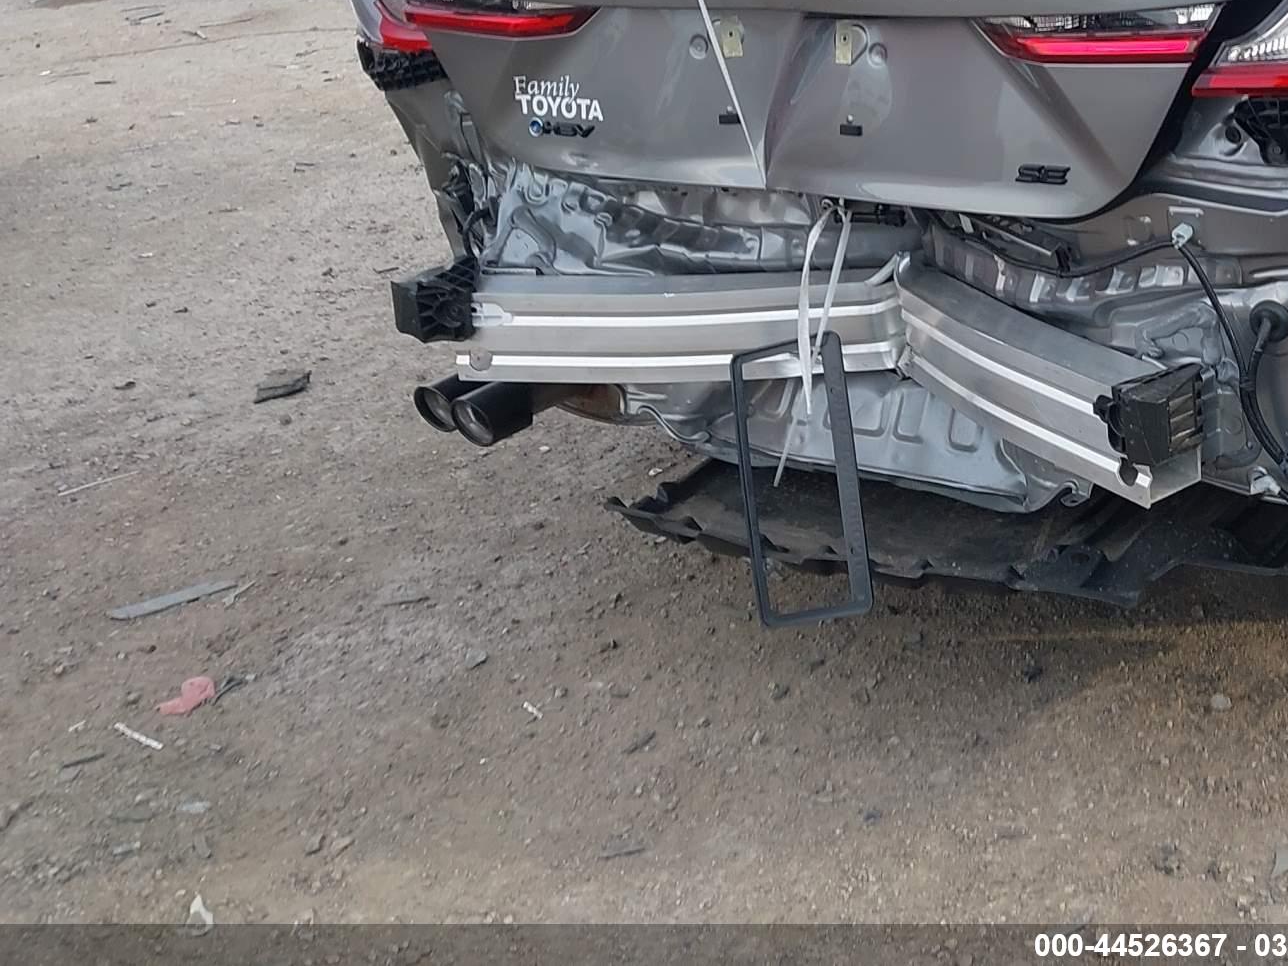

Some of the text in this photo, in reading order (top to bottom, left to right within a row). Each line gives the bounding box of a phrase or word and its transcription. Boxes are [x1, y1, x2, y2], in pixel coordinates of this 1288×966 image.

[513, 75, 580, 104] Family
[515, 93, 604, 122] TOYOTA
[1015, 164, 1071, 185] SE
